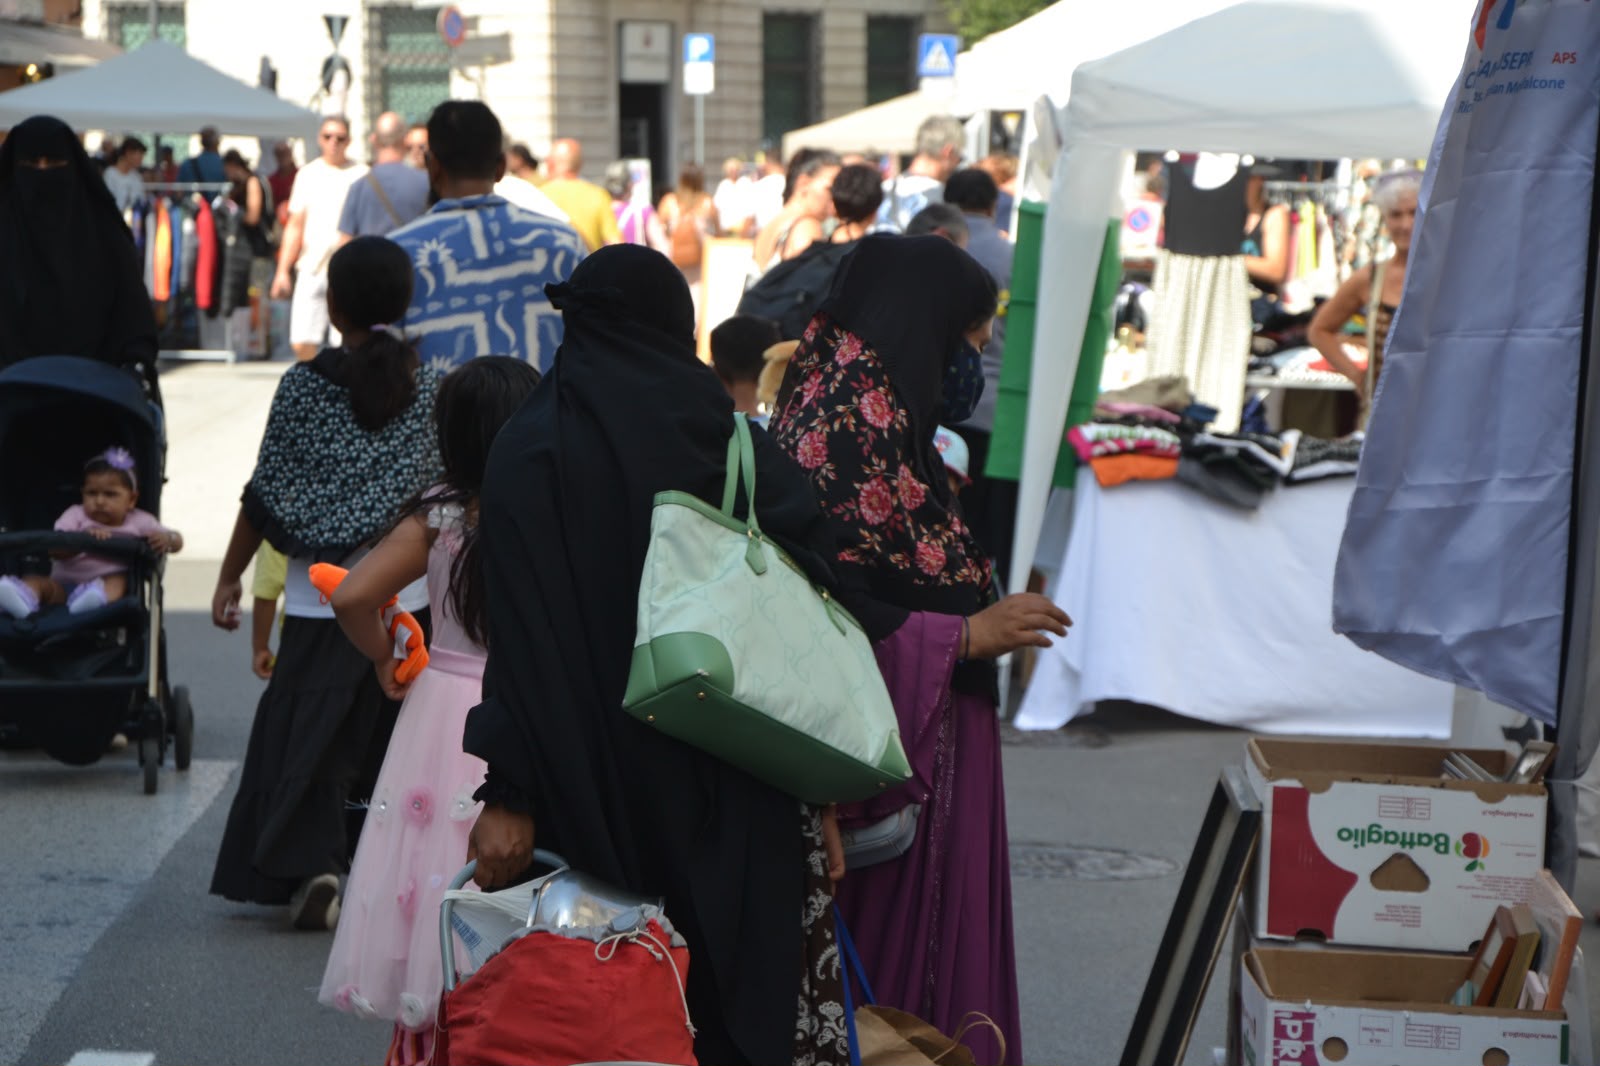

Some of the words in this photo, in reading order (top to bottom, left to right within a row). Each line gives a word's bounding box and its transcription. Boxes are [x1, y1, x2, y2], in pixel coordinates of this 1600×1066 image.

[688, 36, 710, 62] P
[1552, 52, 1577, 65] APS
[1337, 823, 1450, 855] Battaglio
